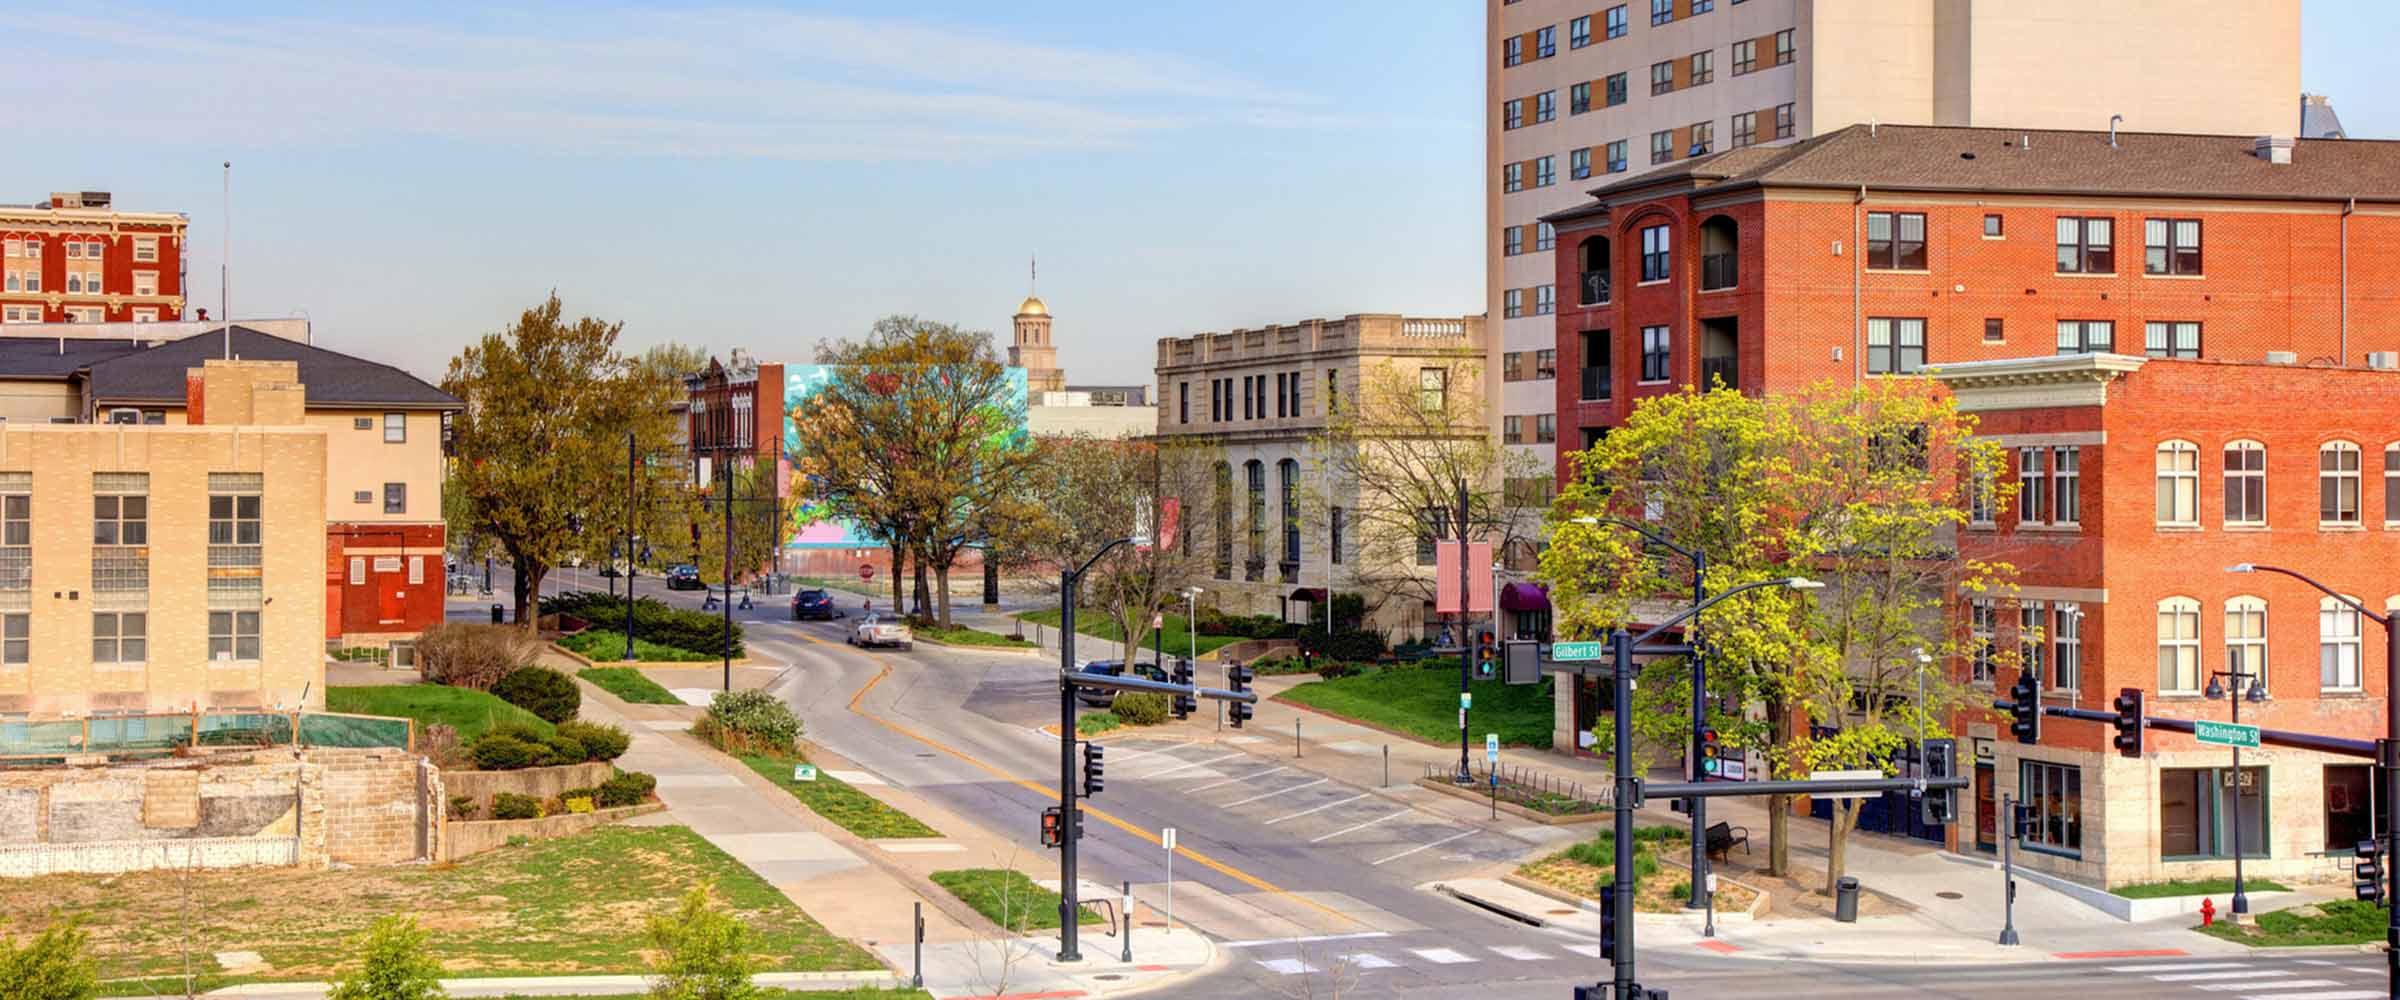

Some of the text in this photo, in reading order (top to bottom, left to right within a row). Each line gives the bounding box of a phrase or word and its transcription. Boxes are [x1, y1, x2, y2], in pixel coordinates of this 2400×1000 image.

[1556, 645, 1598, 657] Gilbert St
[2198, 724, 2258, 743] Washington St
